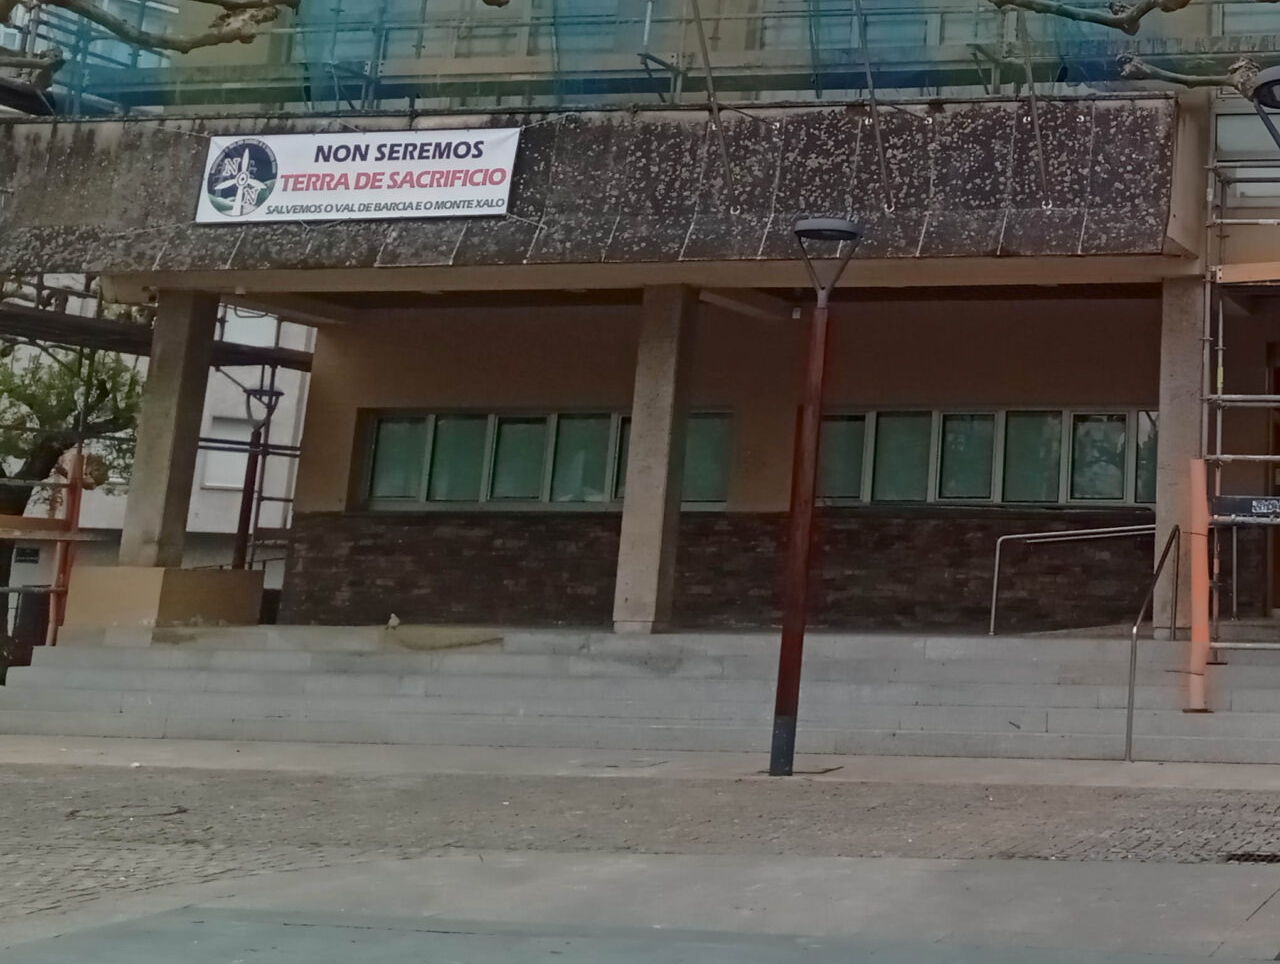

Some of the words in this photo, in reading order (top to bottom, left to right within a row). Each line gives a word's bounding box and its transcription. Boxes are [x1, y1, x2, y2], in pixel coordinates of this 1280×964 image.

[314, 143, 370, 163] NON
[374, 140, 484, 161] SEREMOS
[280, 172, 350, 192] TERRA
[354, 171, 385, 190] DE
[387, 167, 507, 189] SACRIFICIO
[265, 203, 324, 215] SALVEMOS
[323, 203, 334, 213] O
[335, 202, 356, 213] VAL
[357, 202, 373, 212] DE
[373, 201, 414, 212] BARCIA
[414, 201, 423, 211] E
[423, 200, 433, 210] O
[433, 199, 474, 210] MONTE
[474, 198, 505, 209] XALO
